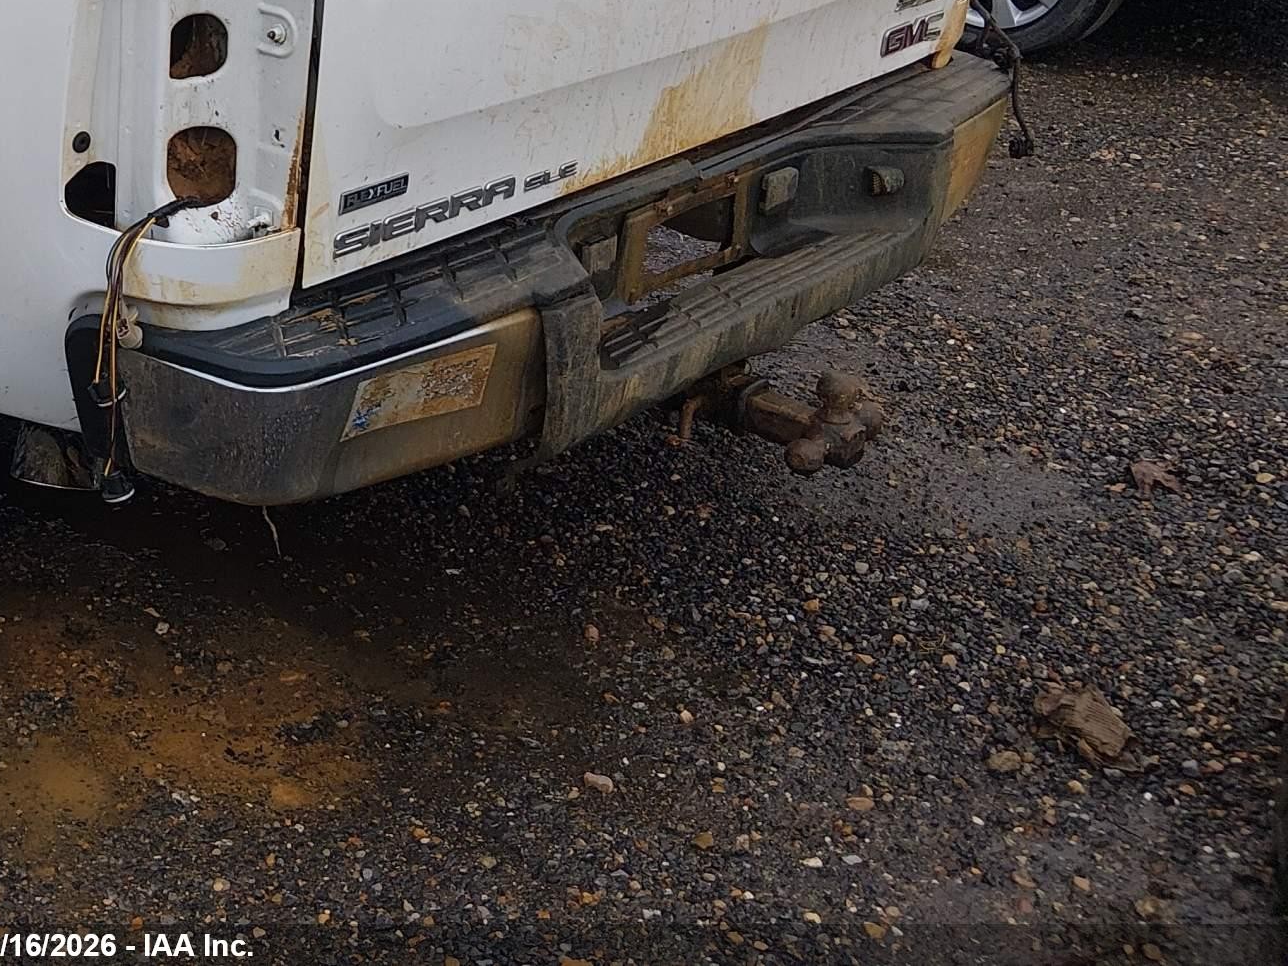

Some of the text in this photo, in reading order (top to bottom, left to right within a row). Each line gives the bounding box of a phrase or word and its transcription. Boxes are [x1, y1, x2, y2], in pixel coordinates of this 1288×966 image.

[880, 9, 945, 59] GMC
[332, 159, 579, 260] SIERRA SLE
